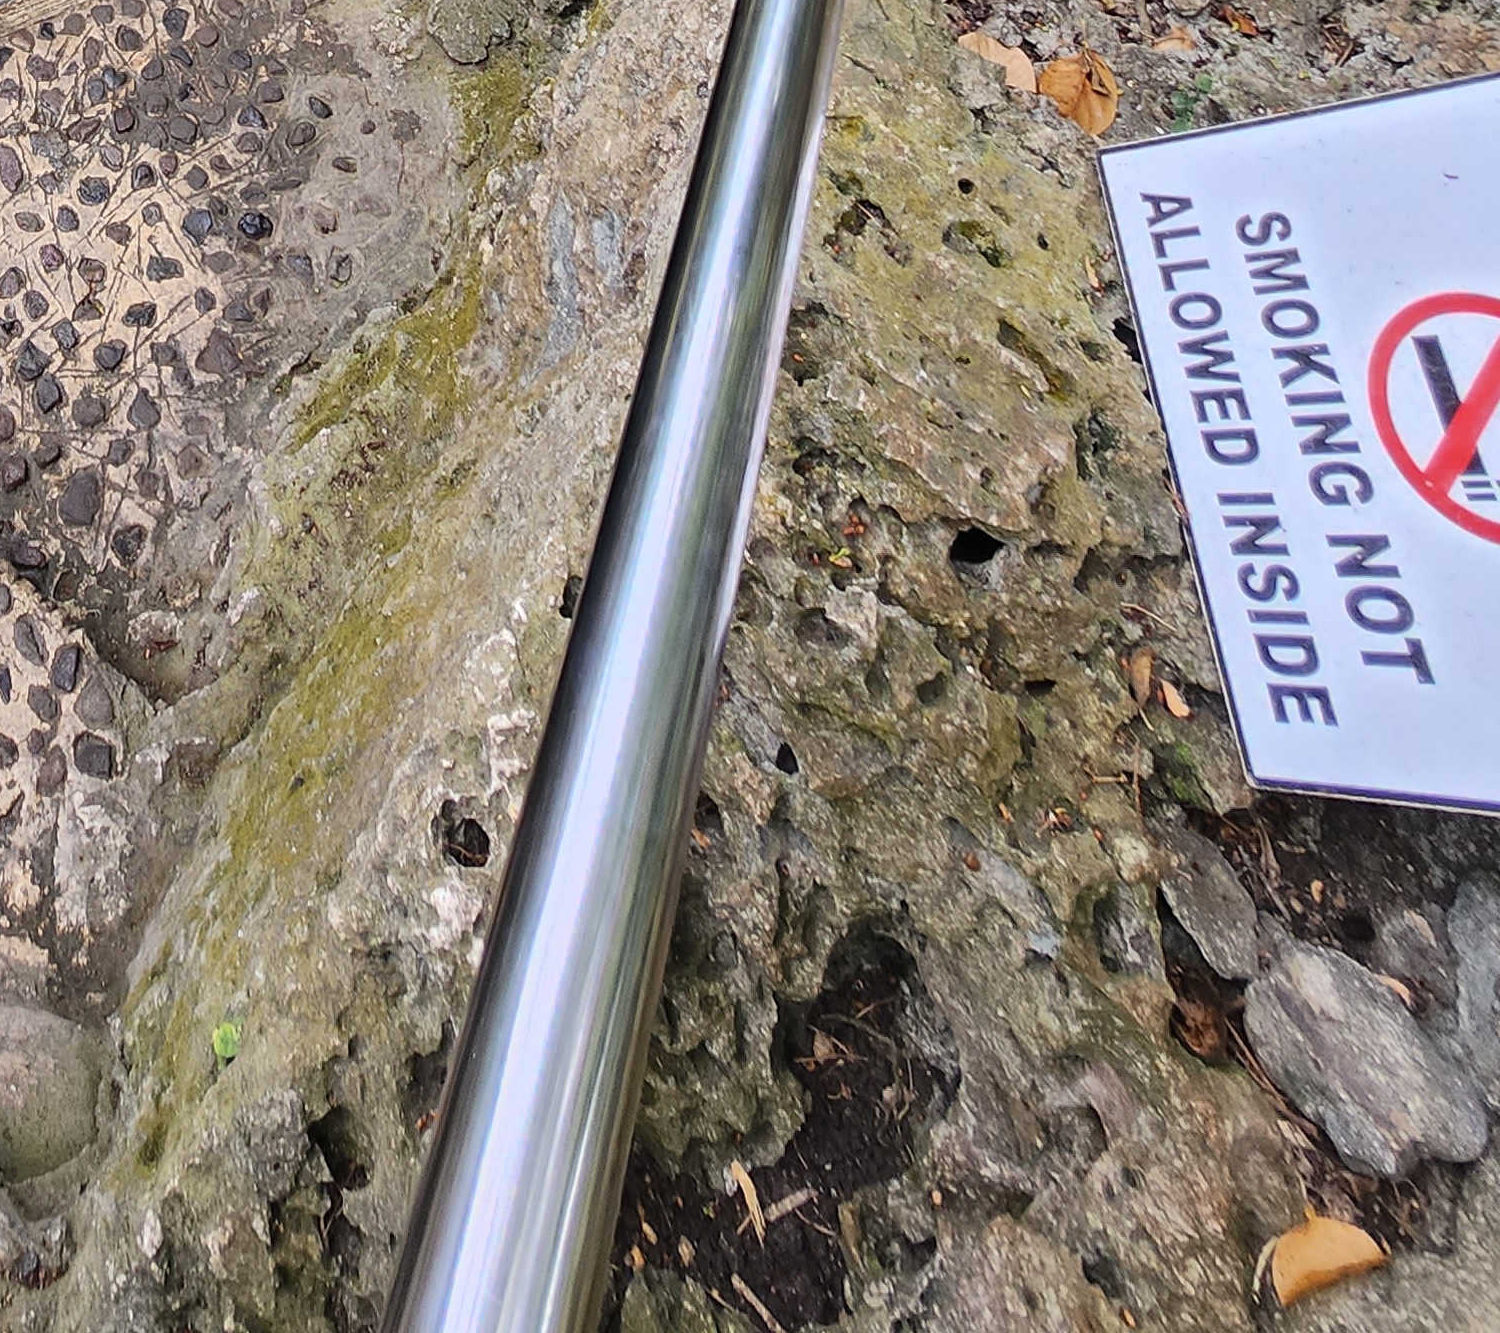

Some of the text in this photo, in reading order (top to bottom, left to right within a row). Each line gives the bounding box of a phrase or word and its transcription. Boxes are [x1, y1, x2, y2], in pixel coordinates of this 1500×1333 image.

[1140, 192, 1339, 727] ALLOWED INSIDE
[1235, 211, 1436, 685] SMOKING NOT
